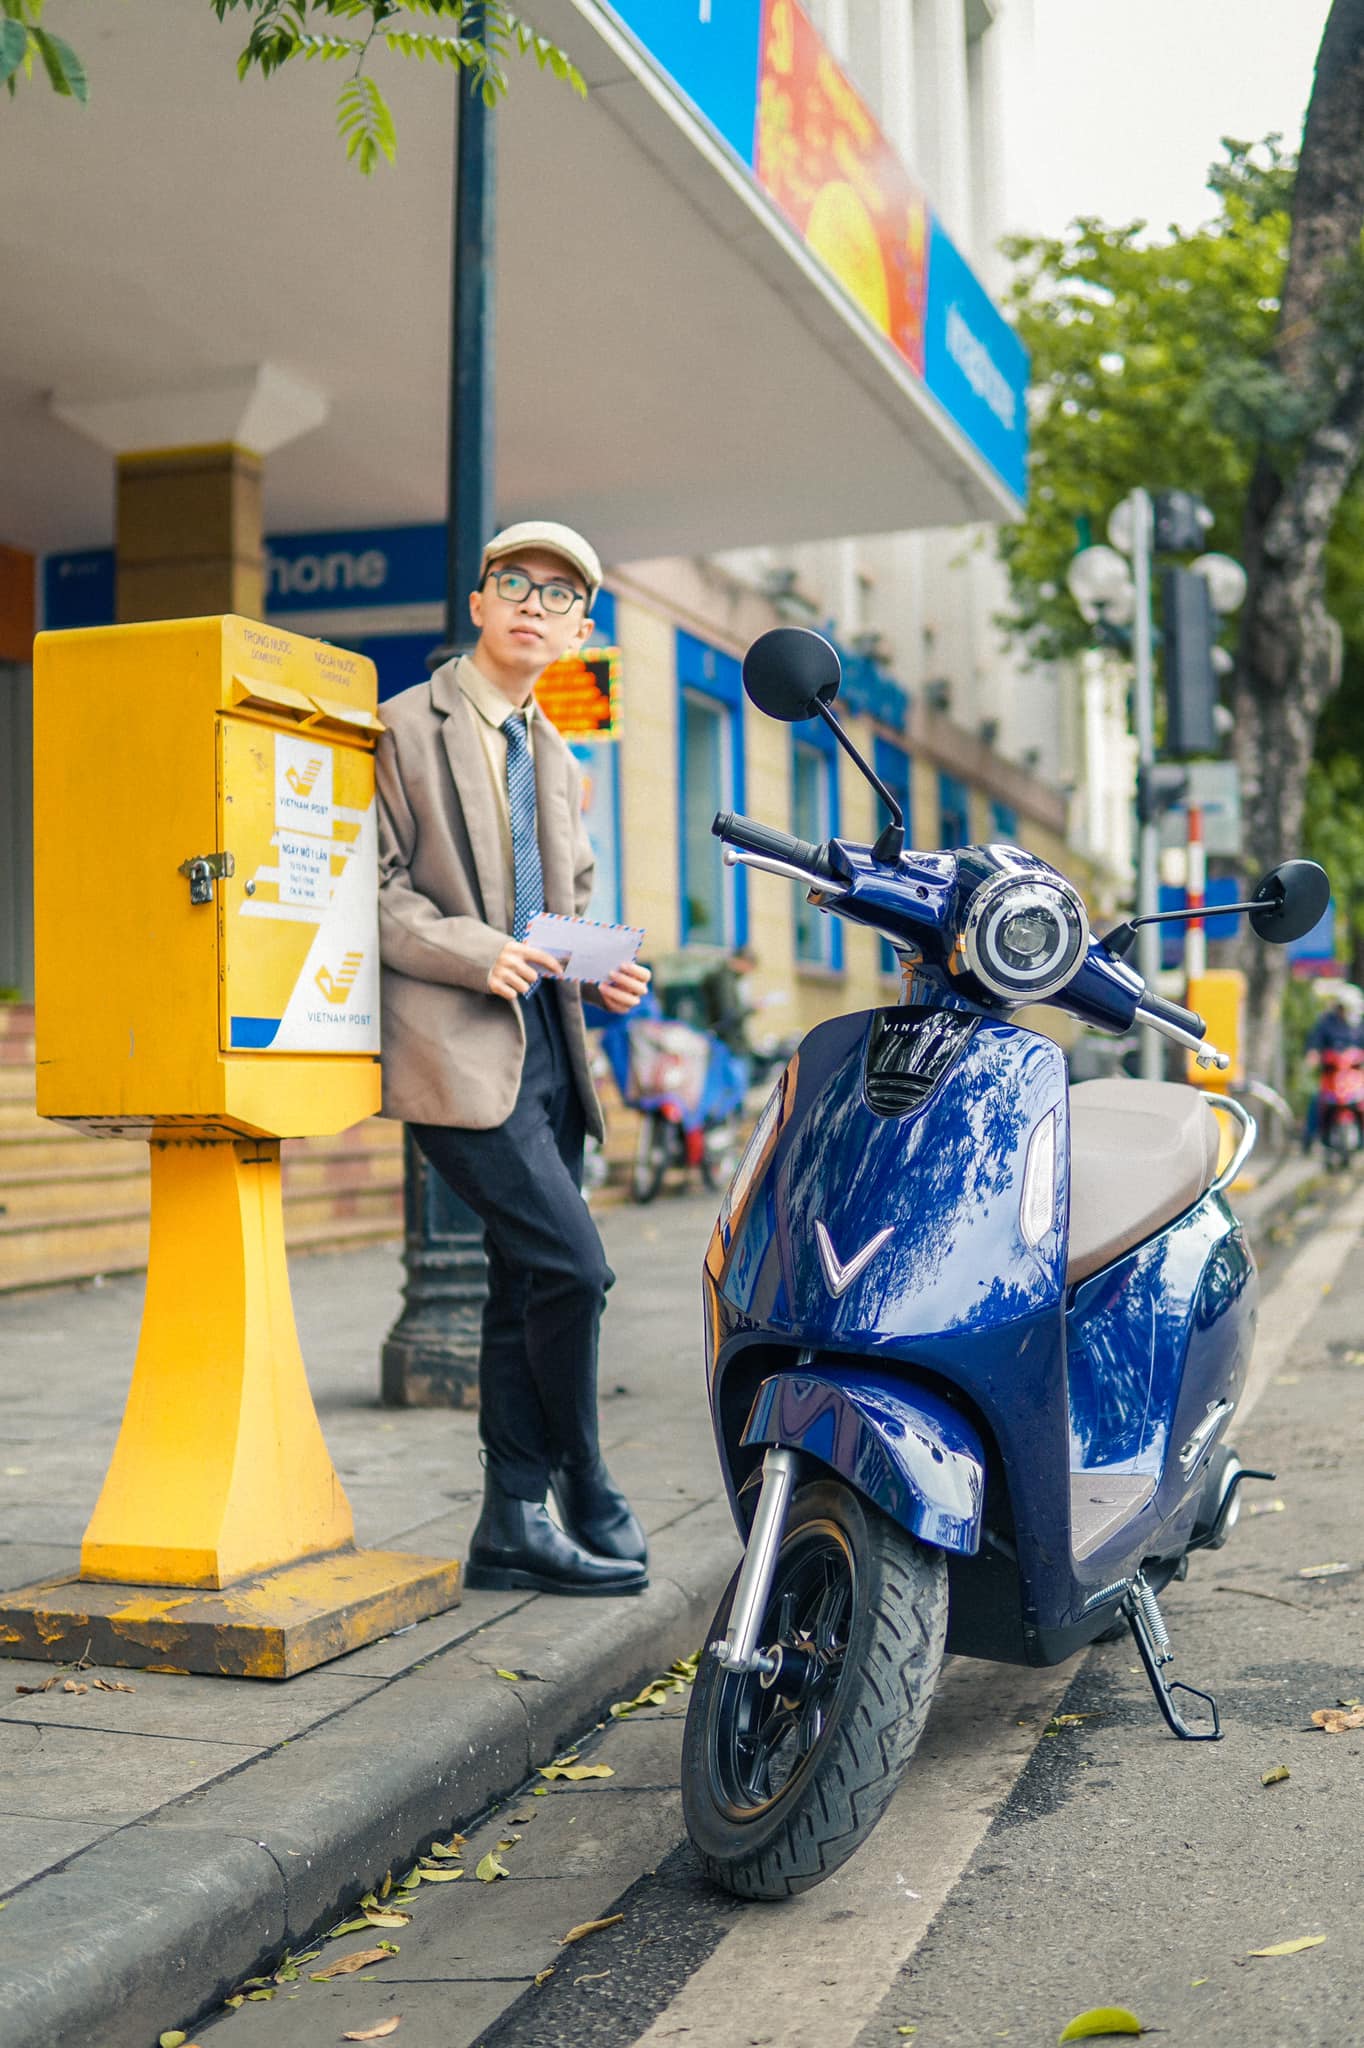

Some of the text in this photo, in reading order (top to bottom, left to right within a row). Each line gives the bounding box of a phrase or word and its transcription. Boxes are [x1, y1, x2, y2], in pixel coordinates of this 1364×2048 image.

[280, 798, 329, 816] VIETNAM POST
[307, 1011, 371, 1025] VIETNAM POST
[884, 1023, 954, 1038] VINFAST
